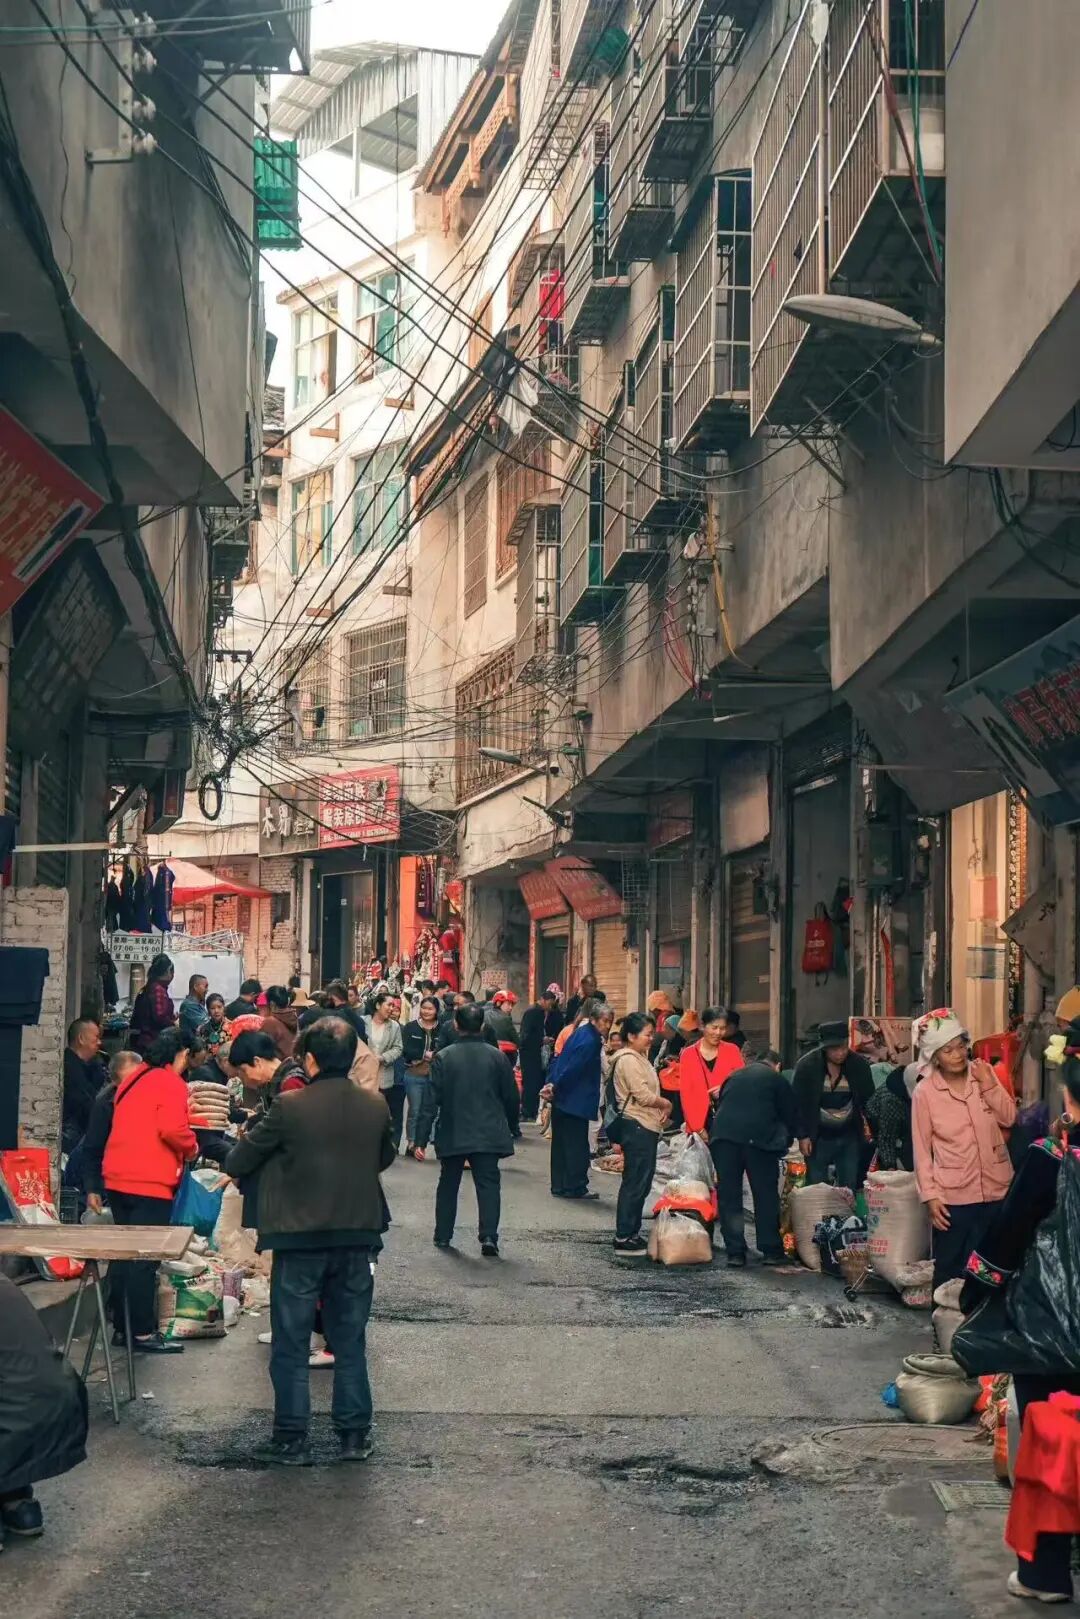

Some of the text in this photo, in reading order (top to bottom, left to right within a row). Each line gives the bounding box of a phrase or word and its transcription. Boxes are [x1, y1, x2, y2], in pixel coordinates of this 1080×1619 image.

[114, 937, 161, 945] 星期一至星期六
